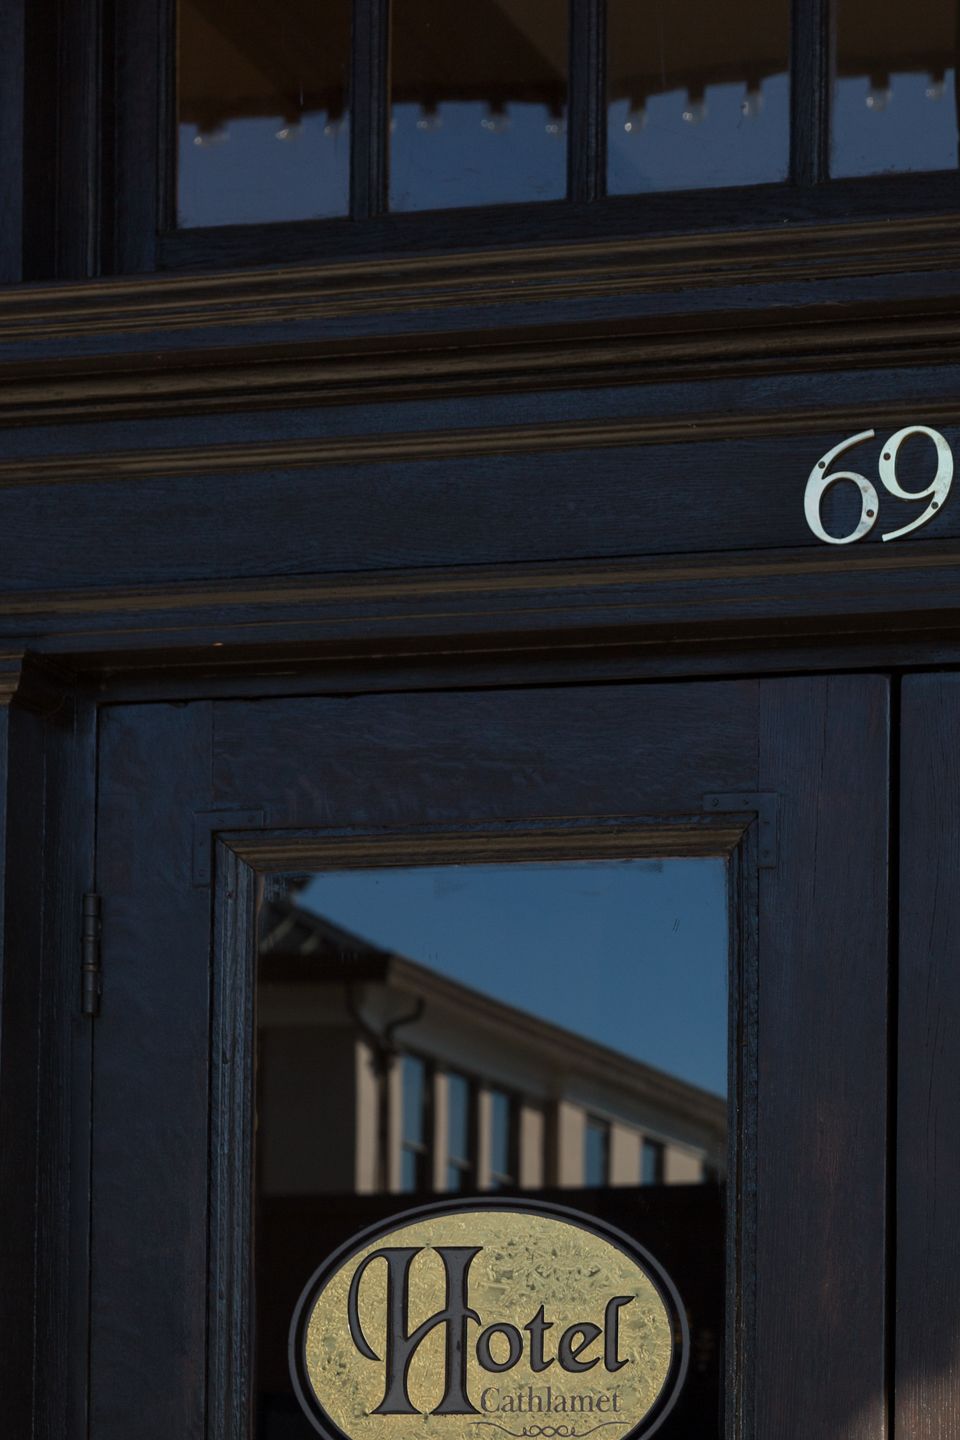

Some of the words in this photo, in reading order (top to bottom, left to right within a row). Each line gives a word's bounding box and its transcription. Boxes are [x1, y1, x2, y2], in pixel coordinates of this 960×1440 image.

[804, 424, 954, 545] 69
[347, 1246, 635, 1416] Hotel
[480, 1387, 622, 1414] Cathlamet
